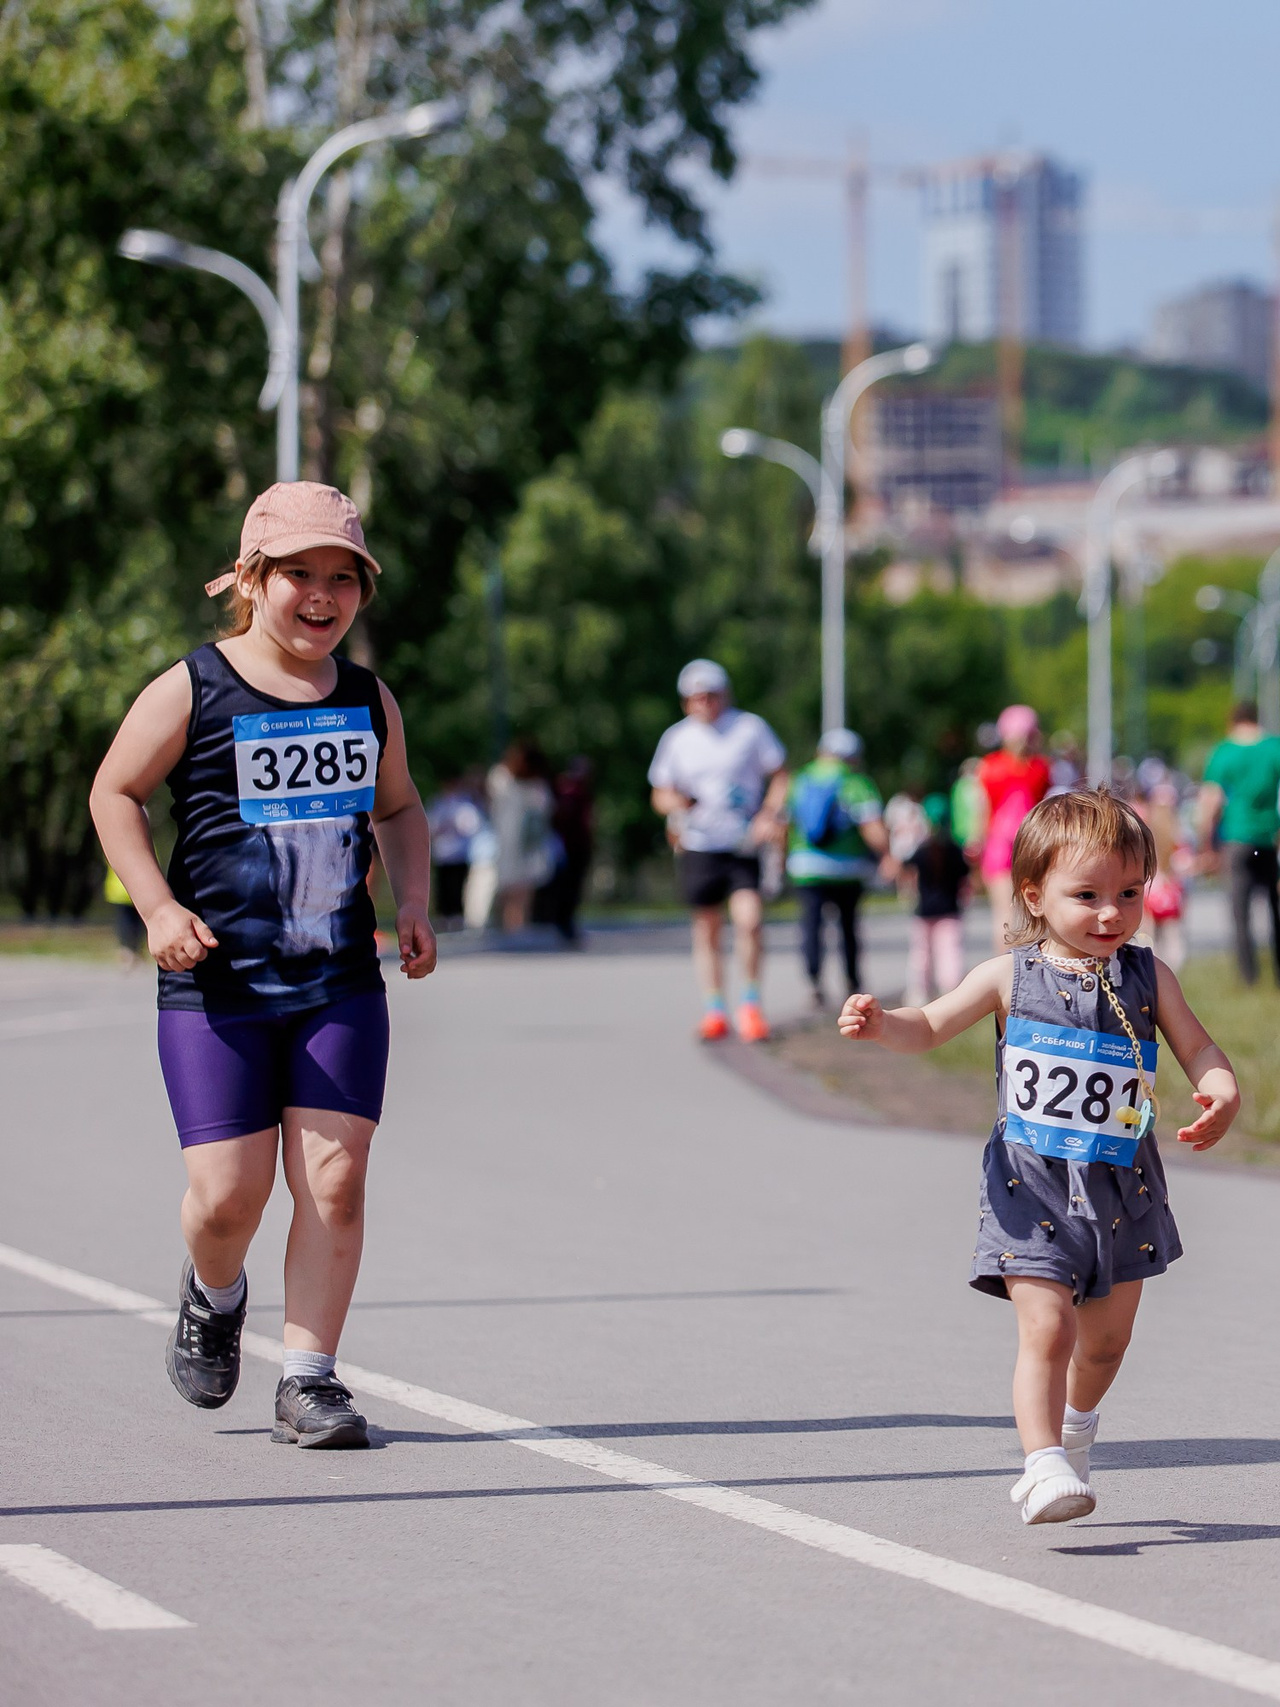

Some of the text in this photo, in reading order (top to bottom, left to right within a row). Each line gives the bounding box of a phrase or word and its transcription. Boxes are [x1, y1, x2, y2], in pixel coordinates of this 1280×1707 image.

[251, 738, 368, 791] 3285
[1042, 1036, 1086, 1050] СБЕР KIDS
[1015, 1059, 1140, 1130] 3281
